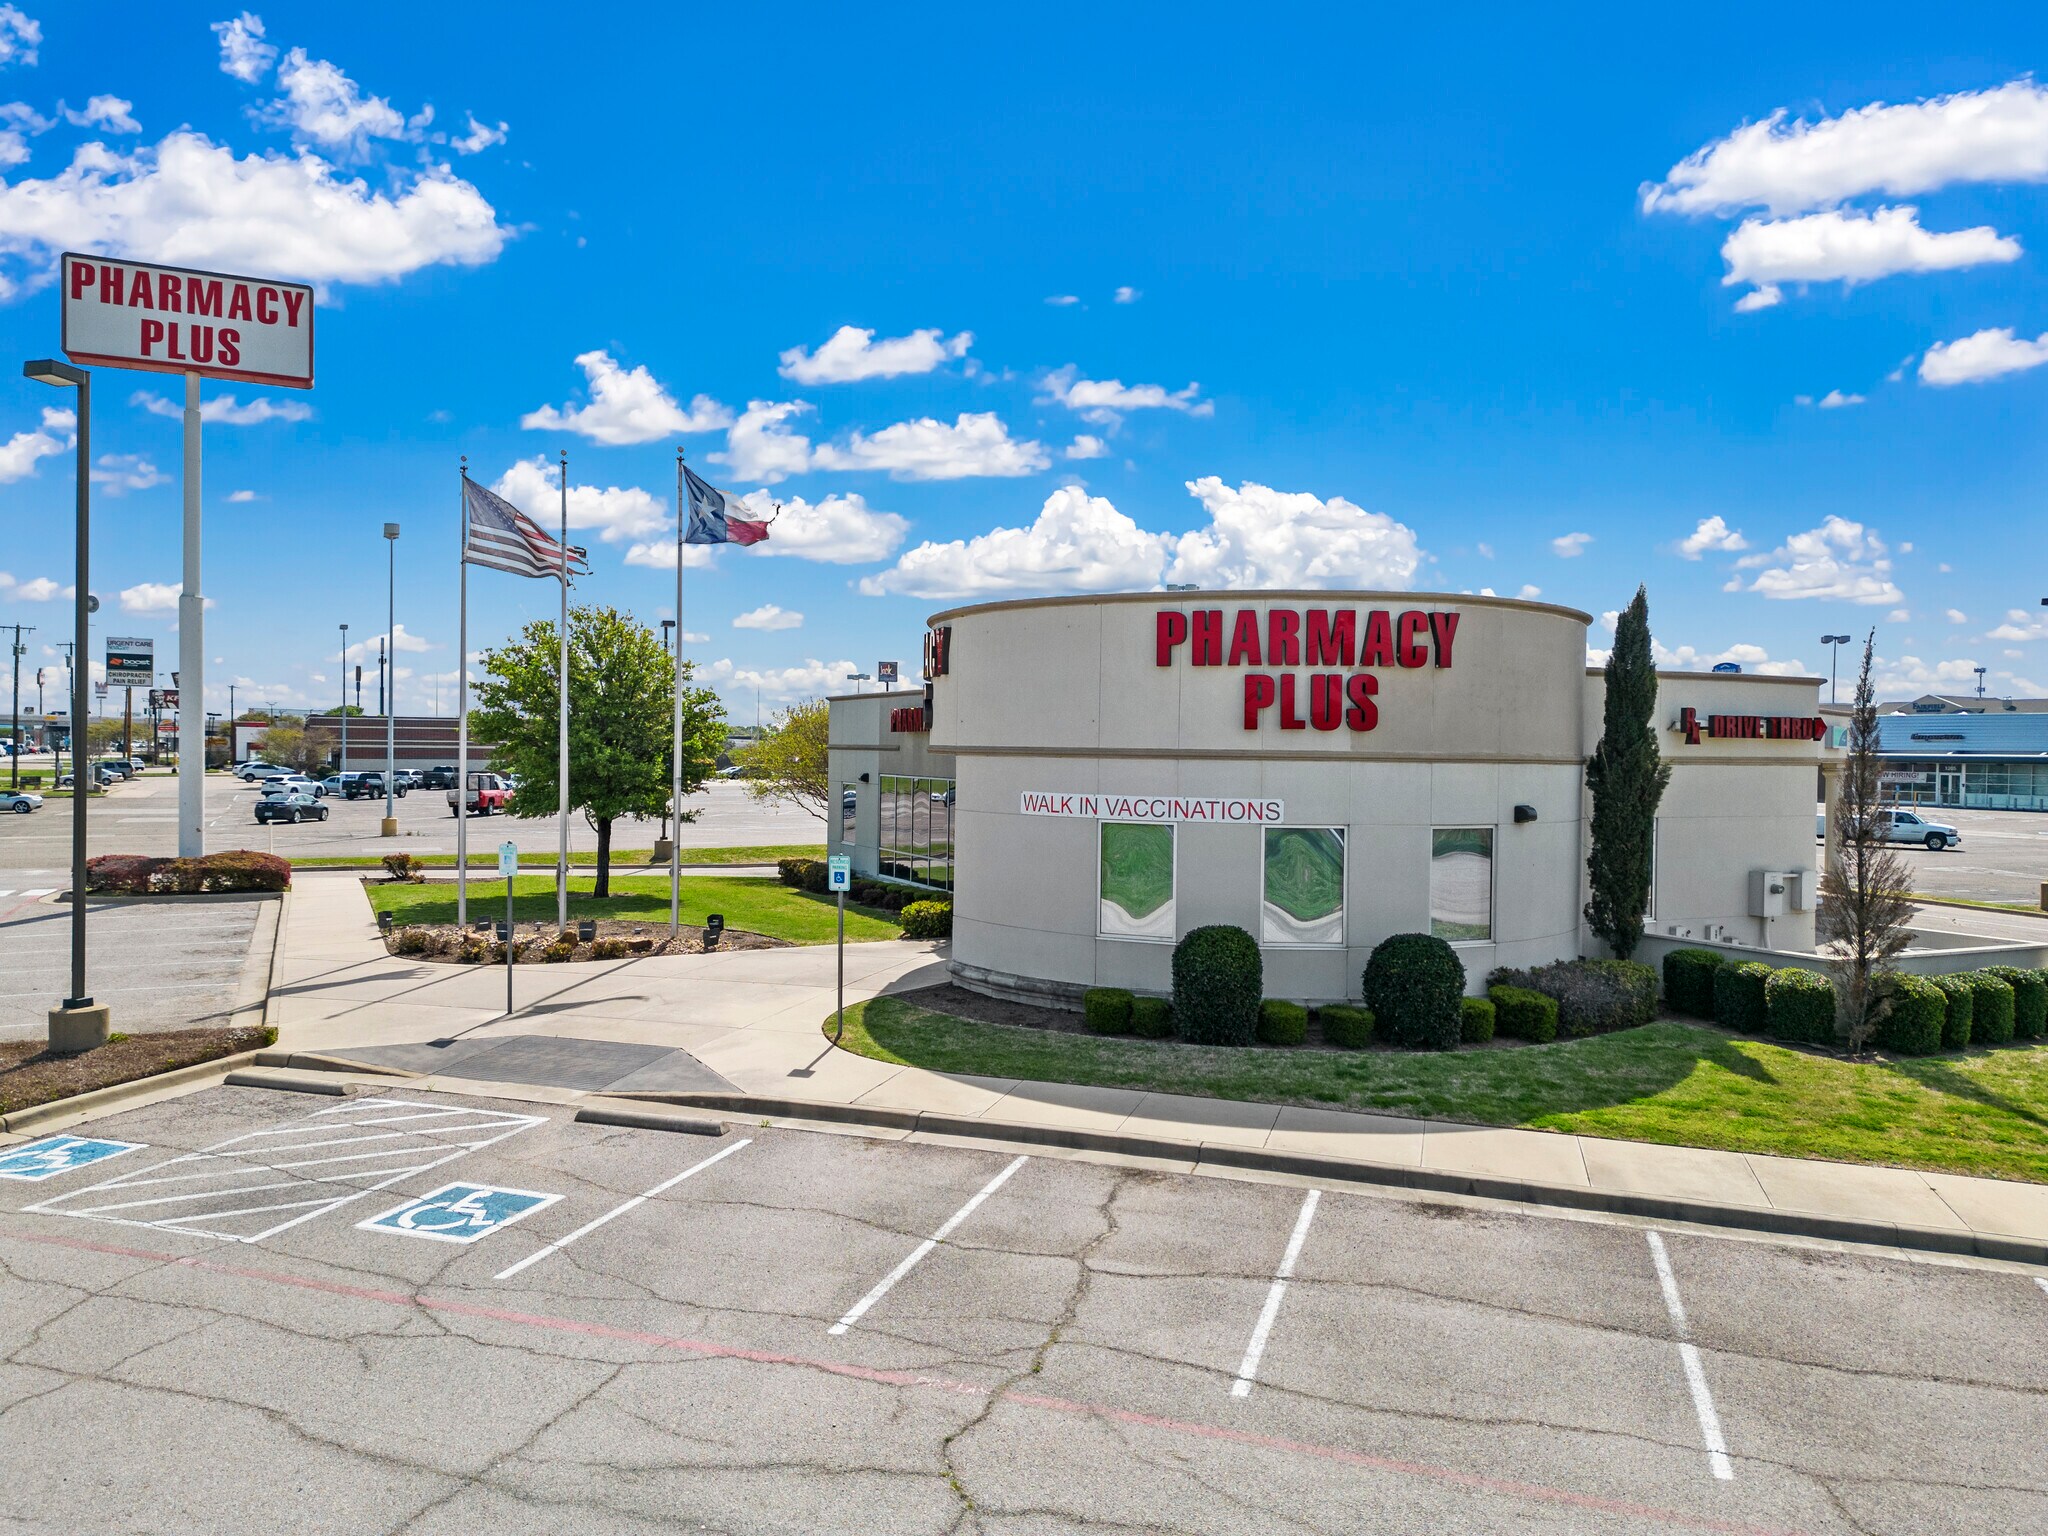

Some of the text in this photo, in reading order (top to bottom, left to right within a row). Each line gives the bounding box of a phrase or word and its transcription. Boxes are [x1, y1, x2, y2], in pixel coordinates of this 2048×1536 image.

[71, 261, 304, 328] PHARMACY
[140, 318, 240, 366] PLUS
[1156, 609, 1461, 669] PHARMACY
[1243, 673, 1379, 732] PLUS
[1709, 715, 1764, 738] DRIVE
[1767, 717, 1813, 740] THRU
[1023, 794, 1281, 821] WALK IN VACCINATIONS
